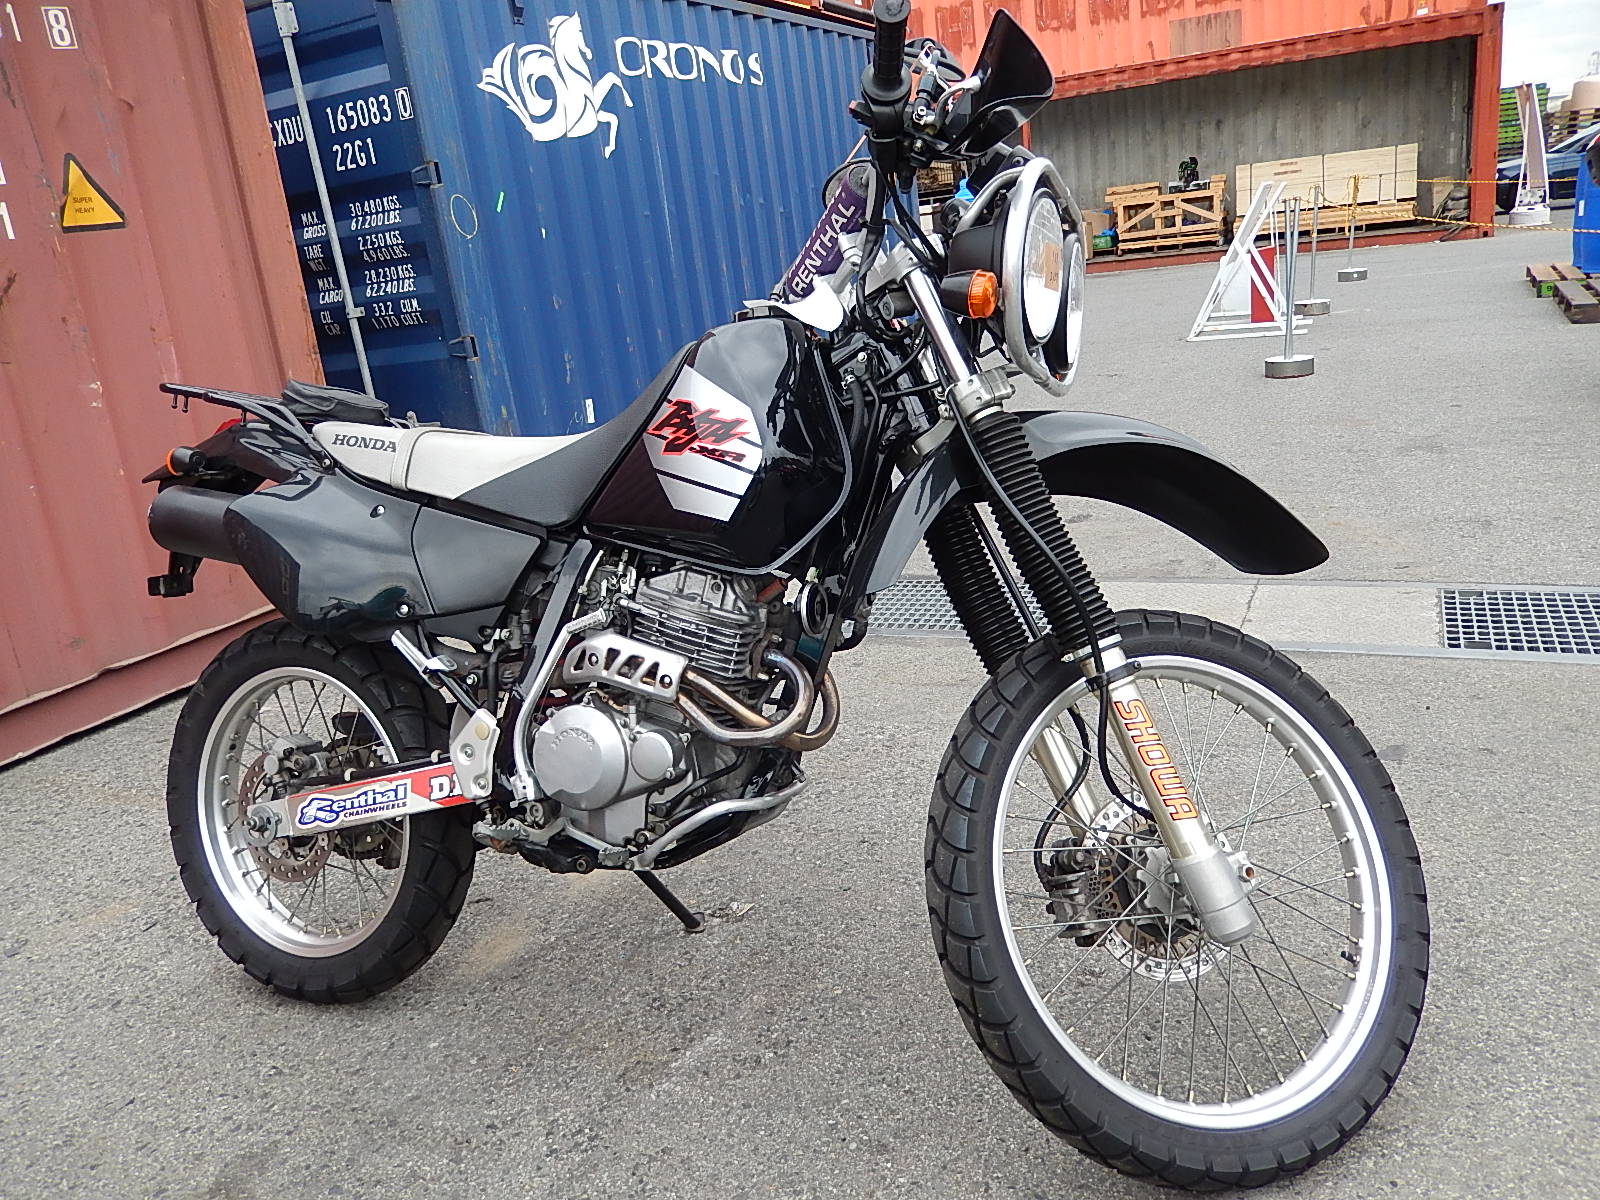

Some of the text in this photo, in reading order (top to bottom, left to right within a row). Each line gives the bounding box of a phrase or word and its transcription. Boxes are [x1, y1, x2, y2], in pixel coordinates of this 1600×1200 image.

[47, 9, 71, 46] 8
[614, 36, 764, 86] CRONOS
[326, 94, 392, 134] 165083
[397, 89, 411, 118] 0
[332, 137, 377, 171] 22G1
[73, 196, 93, 204] SUPER
[301, 195, 402, 226] MAX. 30.480 KGS.
[303, 209, 402, 240] GROSS 67.200 LBS.
[304, 230, 405, 260] TARE 2.250 KGS.
[389, 244, 411, 260] LBS.
[791, 202, 856, 295] RENTHAL
[317, 263, 417, 292] MAX. 28.230 KGS.
[320, 278, 417, 305] CARGO 62.240 LBS.
[373, 301, 395, 317] 33.2
[331, 433, 398, 453] HONDA
[1113, 698, 1199, 821] SHOWA
[298, 781, 408, 825] Renthal
[343, 801, 408, 819] CHAINWHEELS
